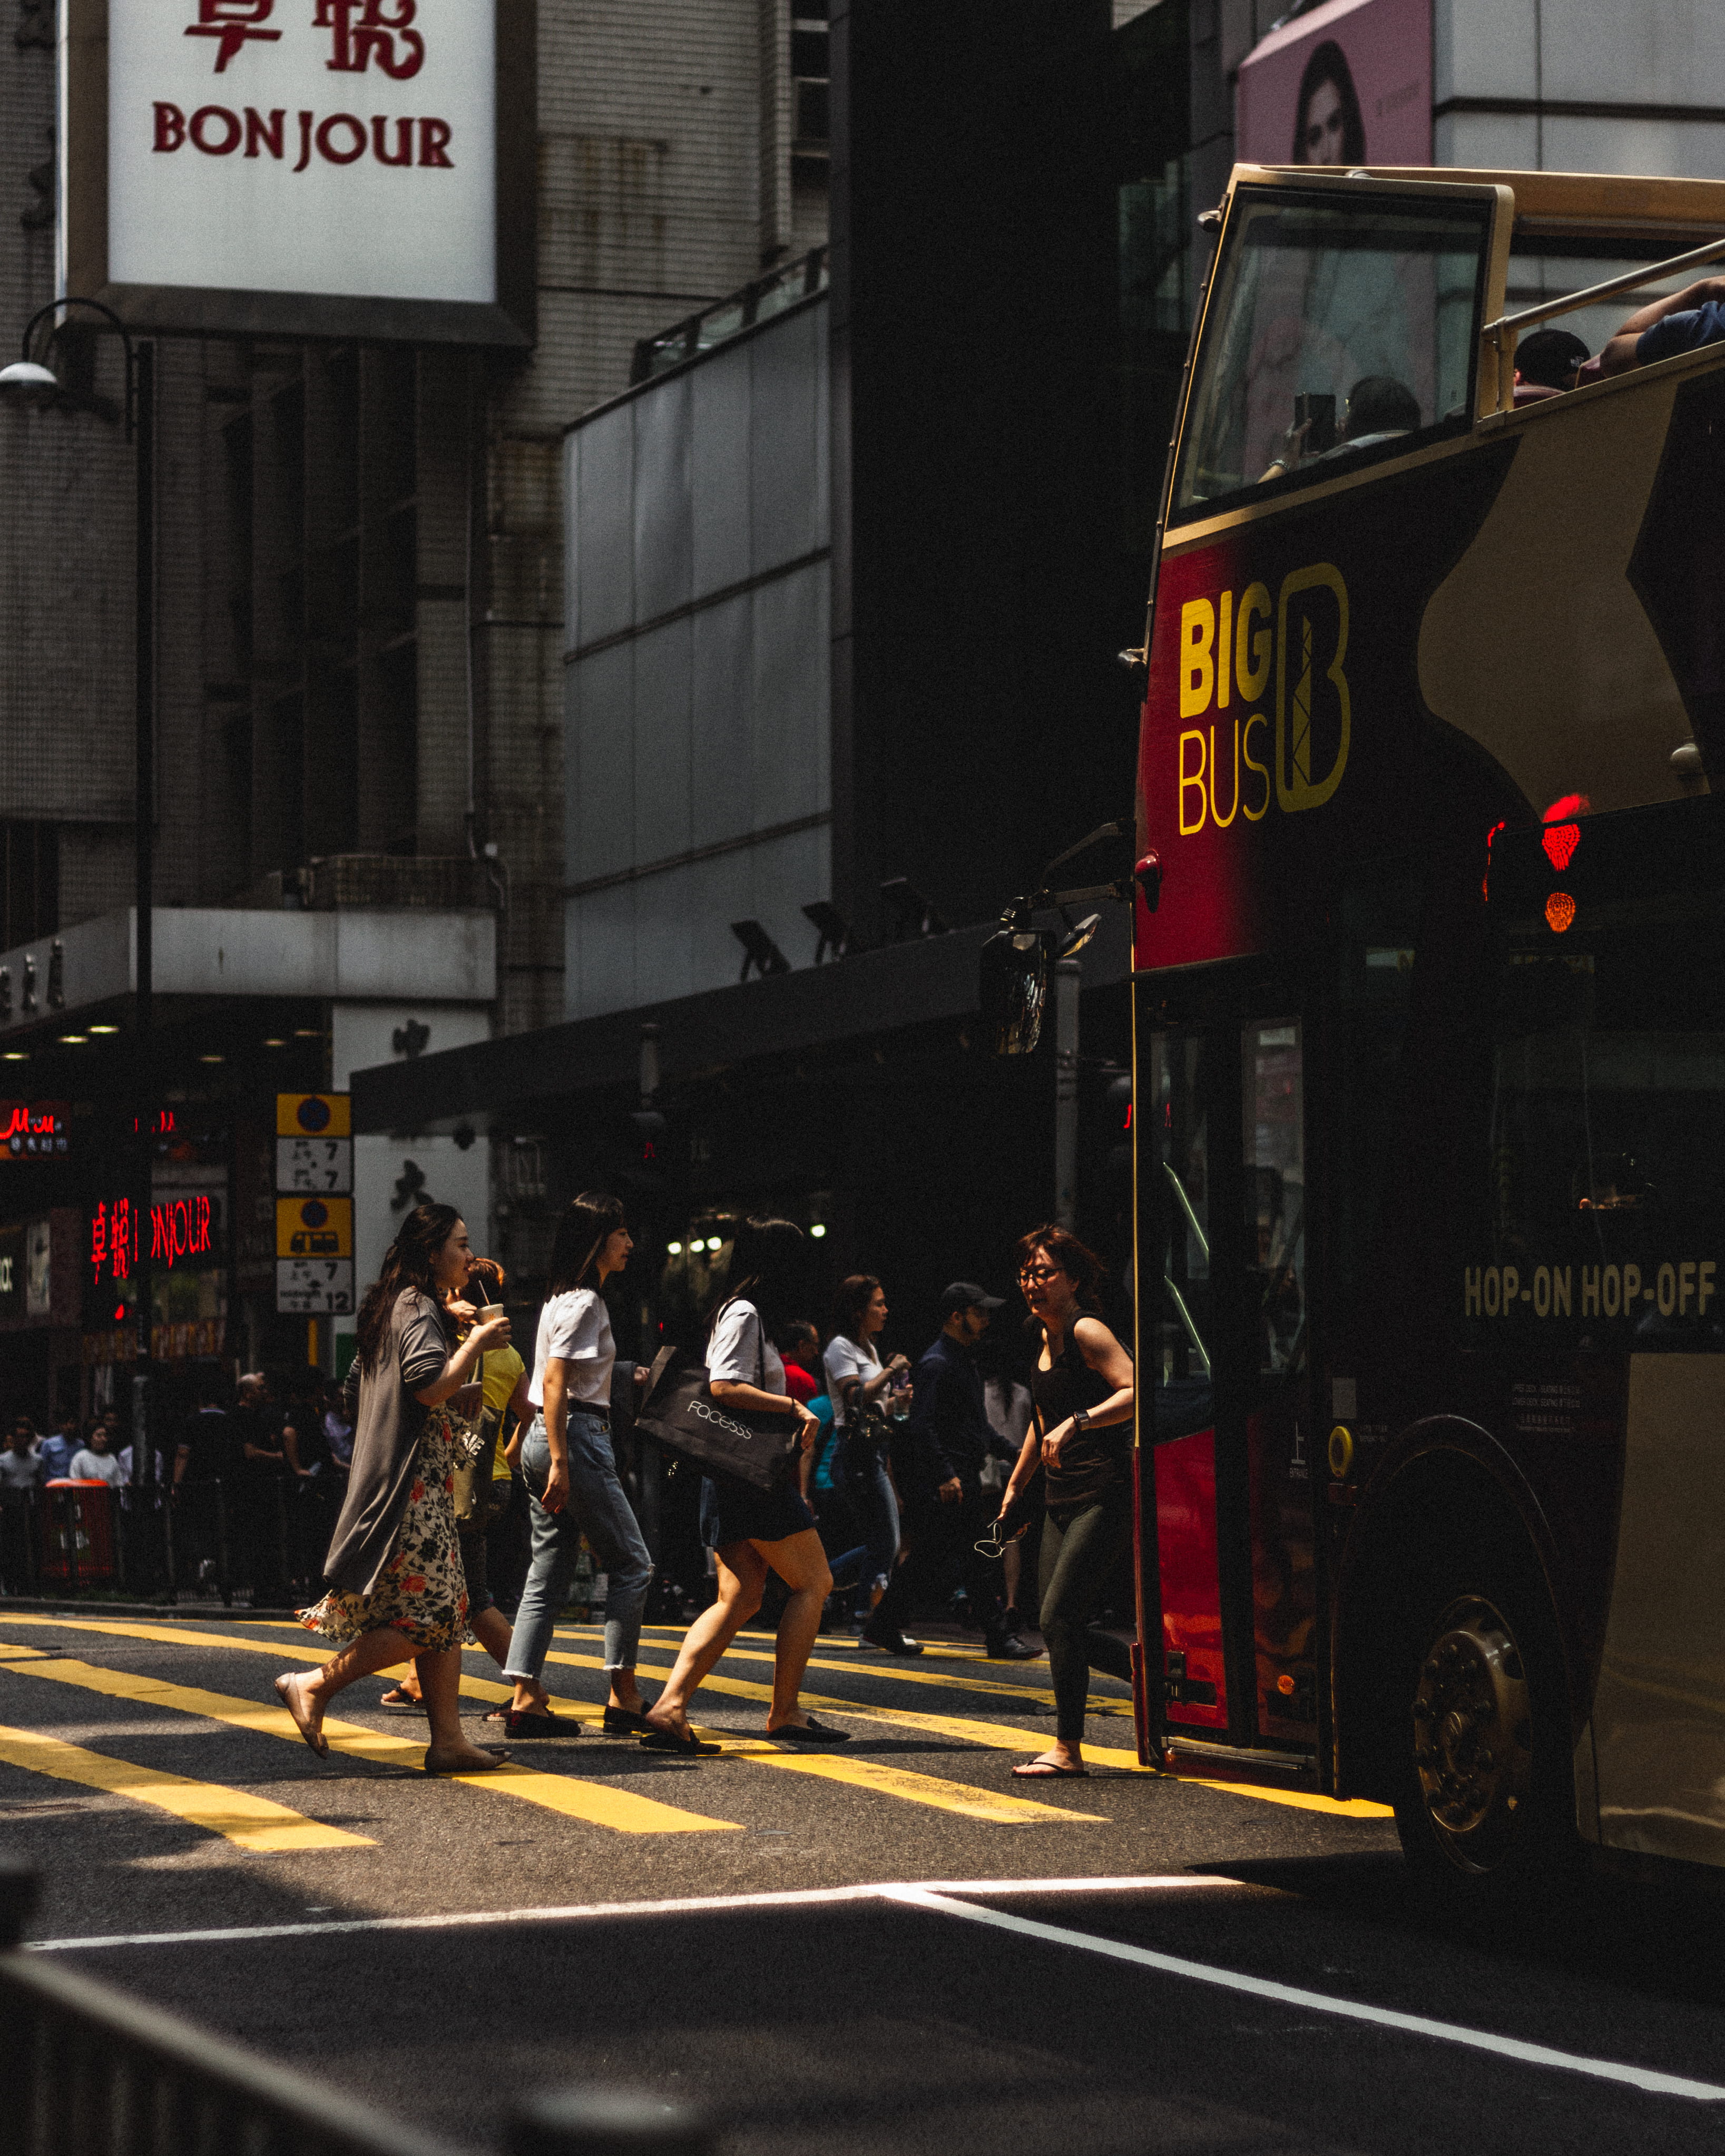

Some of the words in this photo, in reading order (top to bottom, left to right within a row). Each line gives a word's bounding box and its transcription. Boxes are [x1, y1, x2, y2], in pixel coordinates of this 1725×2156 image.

[152, 102, 454, 172] BONJOUR
[1180, 582, 1272, 719] BIG
[1179, 713, 1270, 836] BUS
[325, 1142, 338, 1160] 7
[325, 1170, 338, 1189] 7
[325, 1262, 338, 1280] 7
[1464, 1265, 1572, 1317] HOP-ON
[1581, 1261, 1717, 1317] HOP-OFF
[326, 1291, 348, 1310] 12
